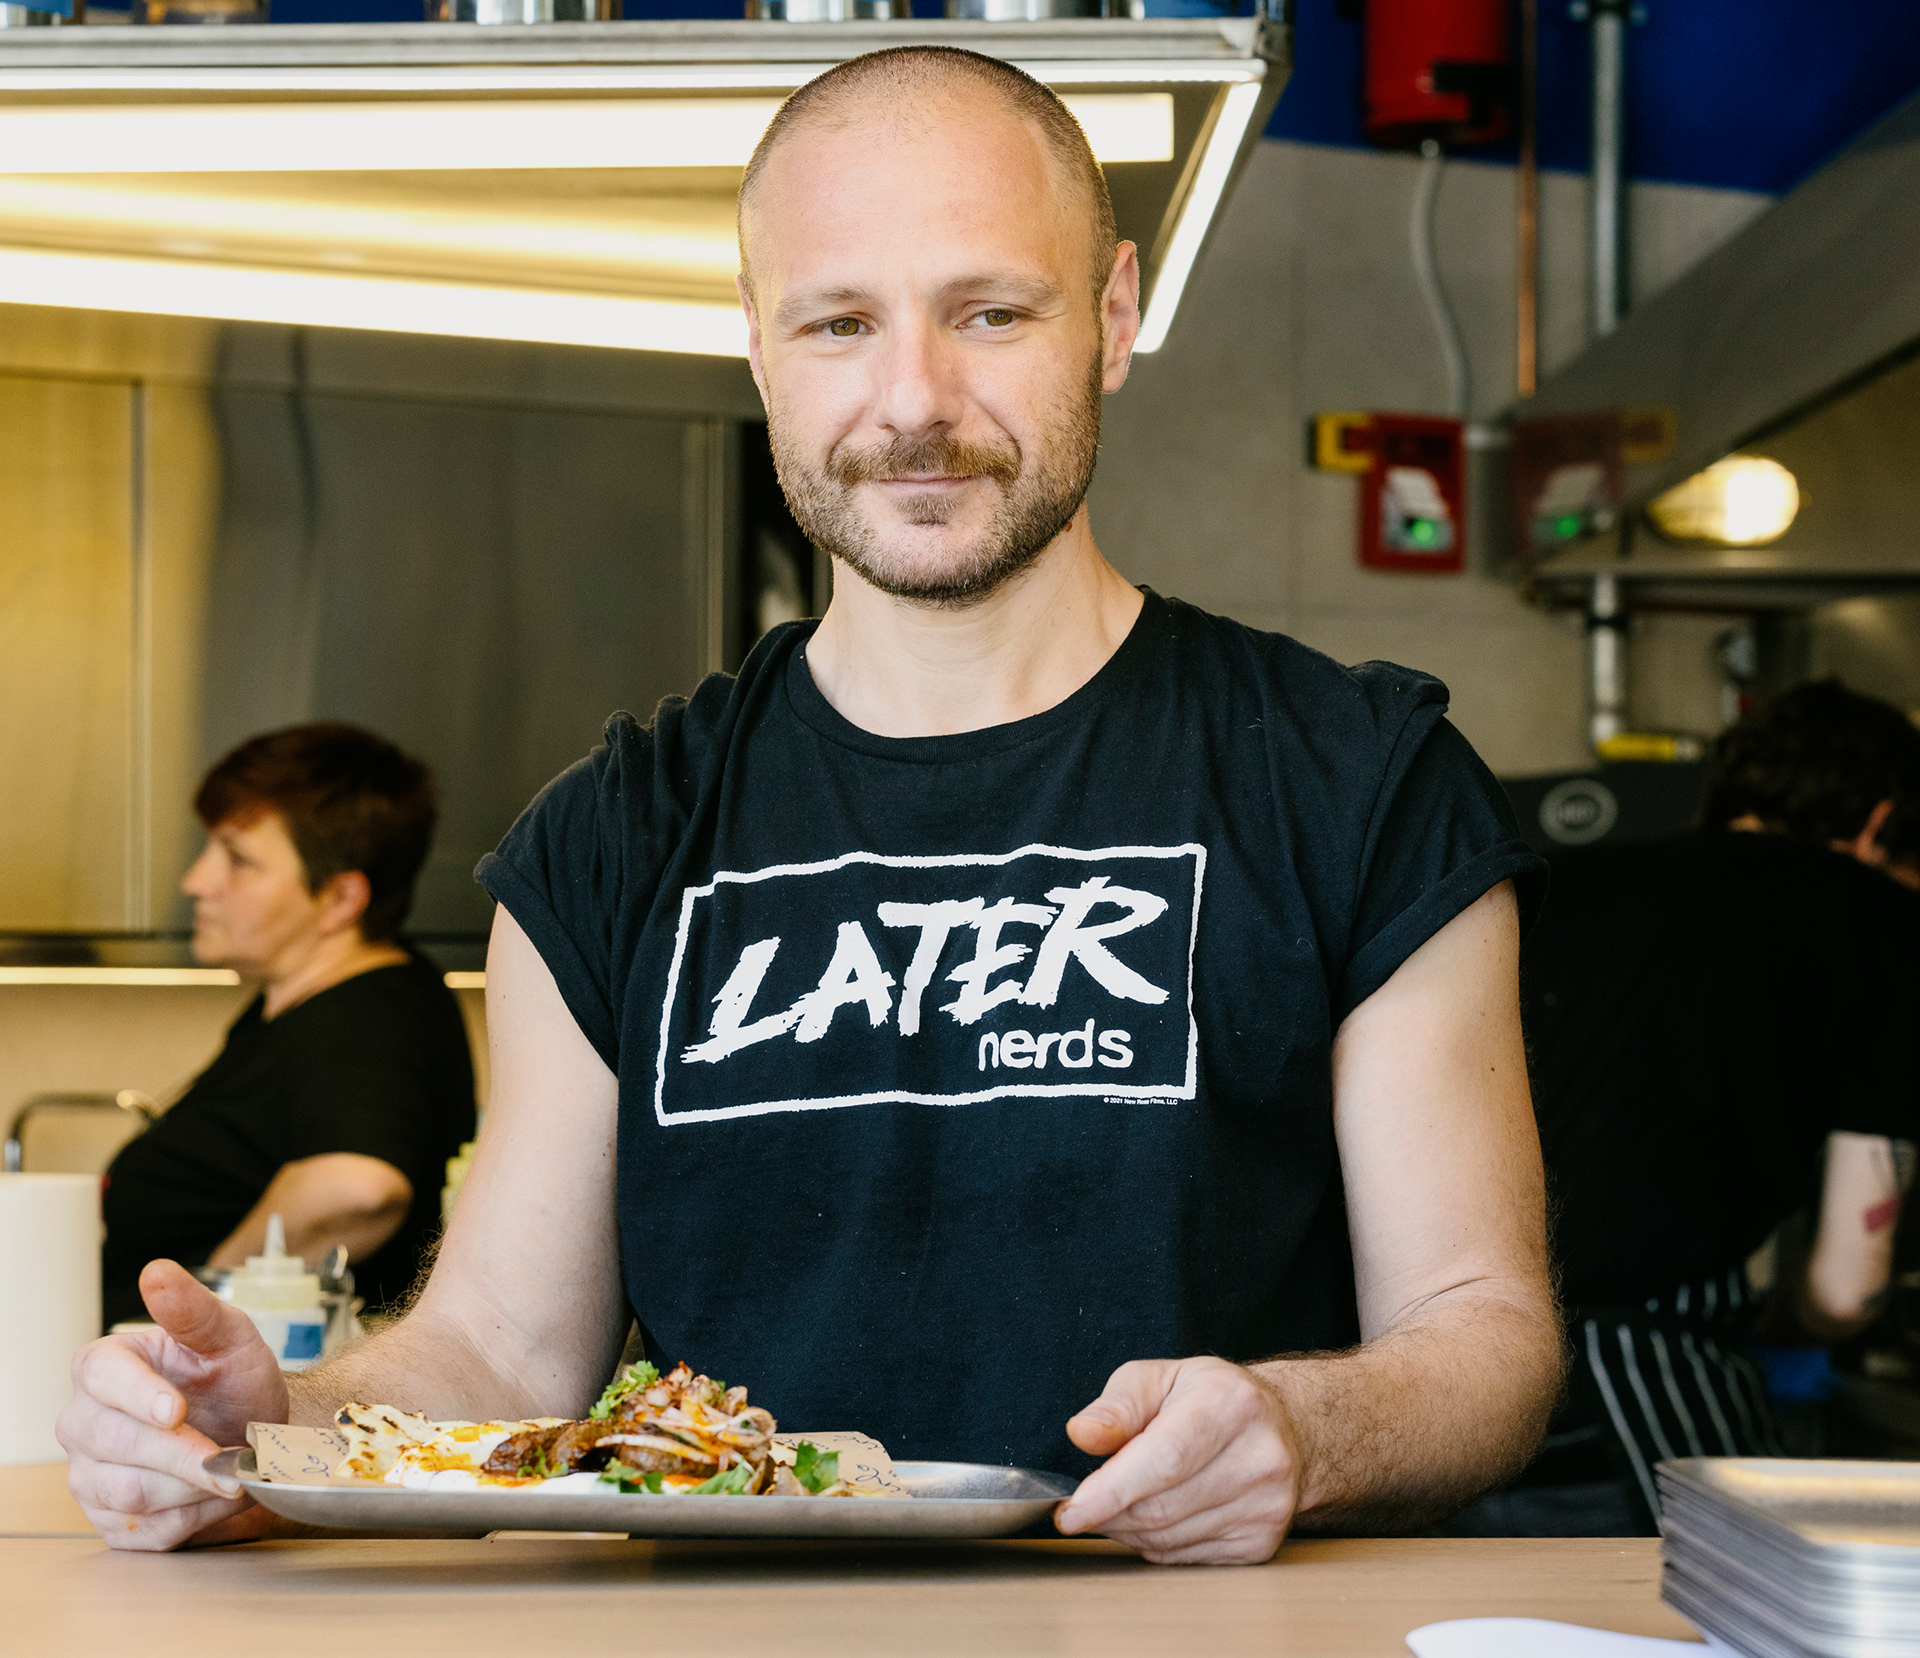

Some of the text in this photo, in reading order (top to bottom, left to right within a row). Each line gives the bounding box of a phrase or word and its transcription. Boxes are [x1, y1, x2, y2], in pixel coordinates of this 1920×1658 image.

[680, 876, 1170, 1064] LATER
[978, 1018, 1134, 1072] nerds
[1166, 1098, 1178, 1106] LLC
